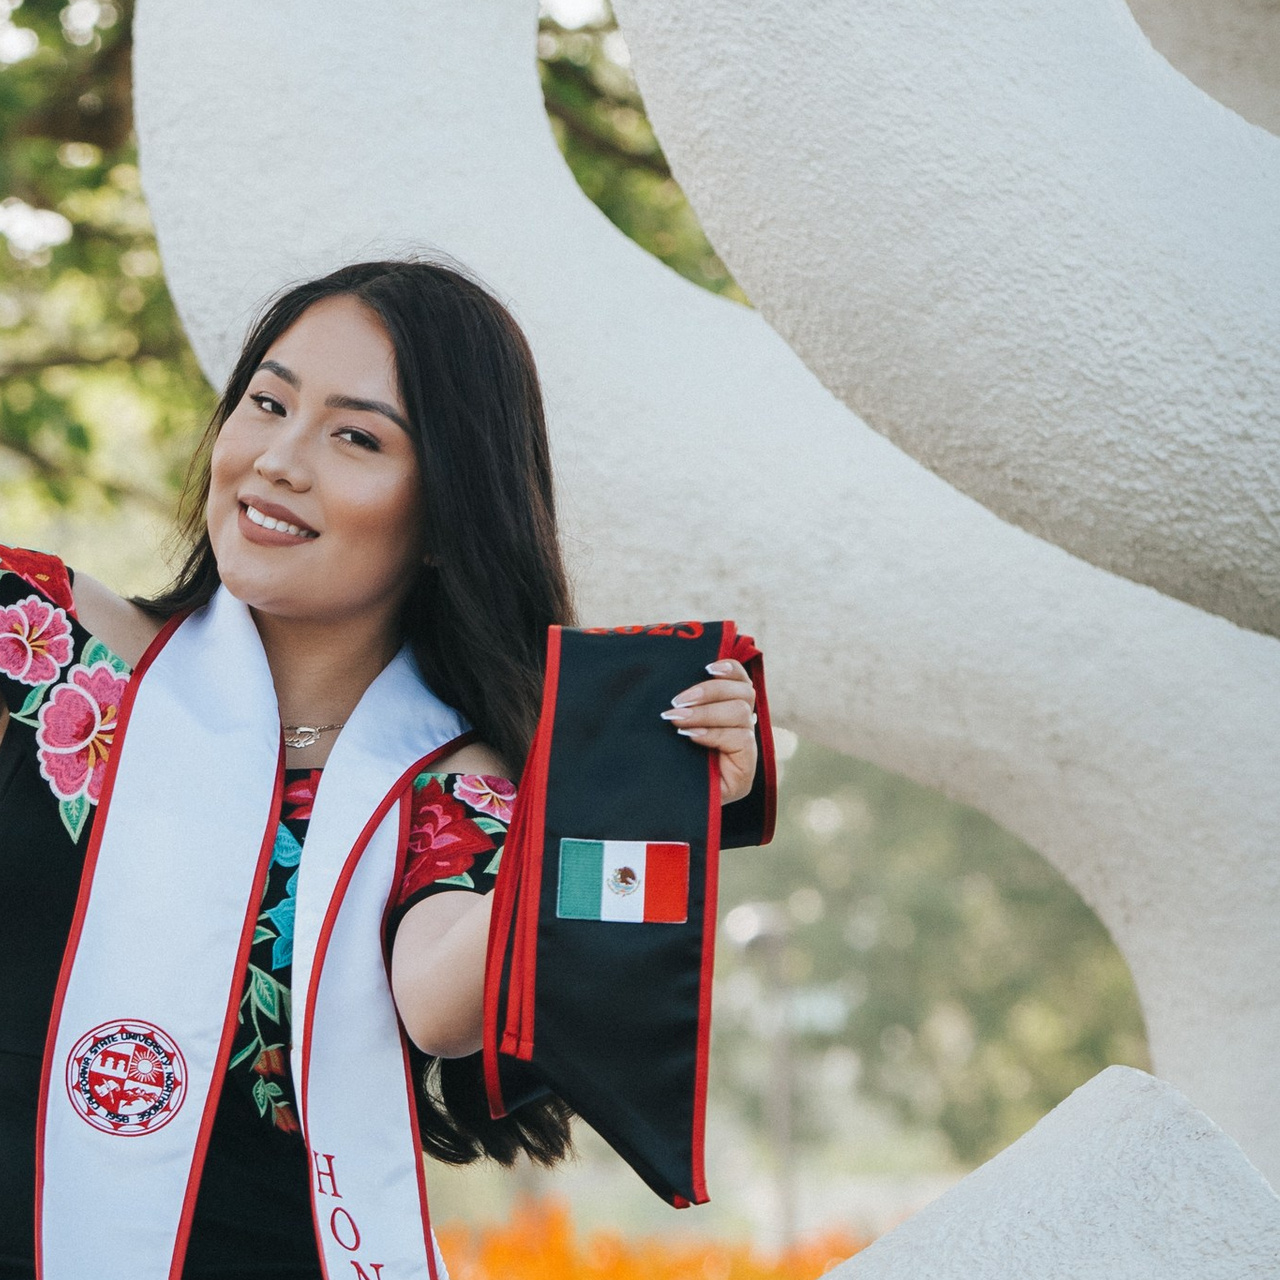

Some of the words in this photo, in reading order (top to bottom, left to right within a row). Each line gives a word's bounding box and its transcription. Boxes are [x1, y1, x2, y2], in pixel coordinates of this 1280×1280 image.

[89, 1033, 119, 1056] STATE
[79, 1056, 100, 1111] CALIFORNIA
[137, 1071, 174, 1122] NORTHRIDGE
[105, 1110, 130, 1123] 1958
